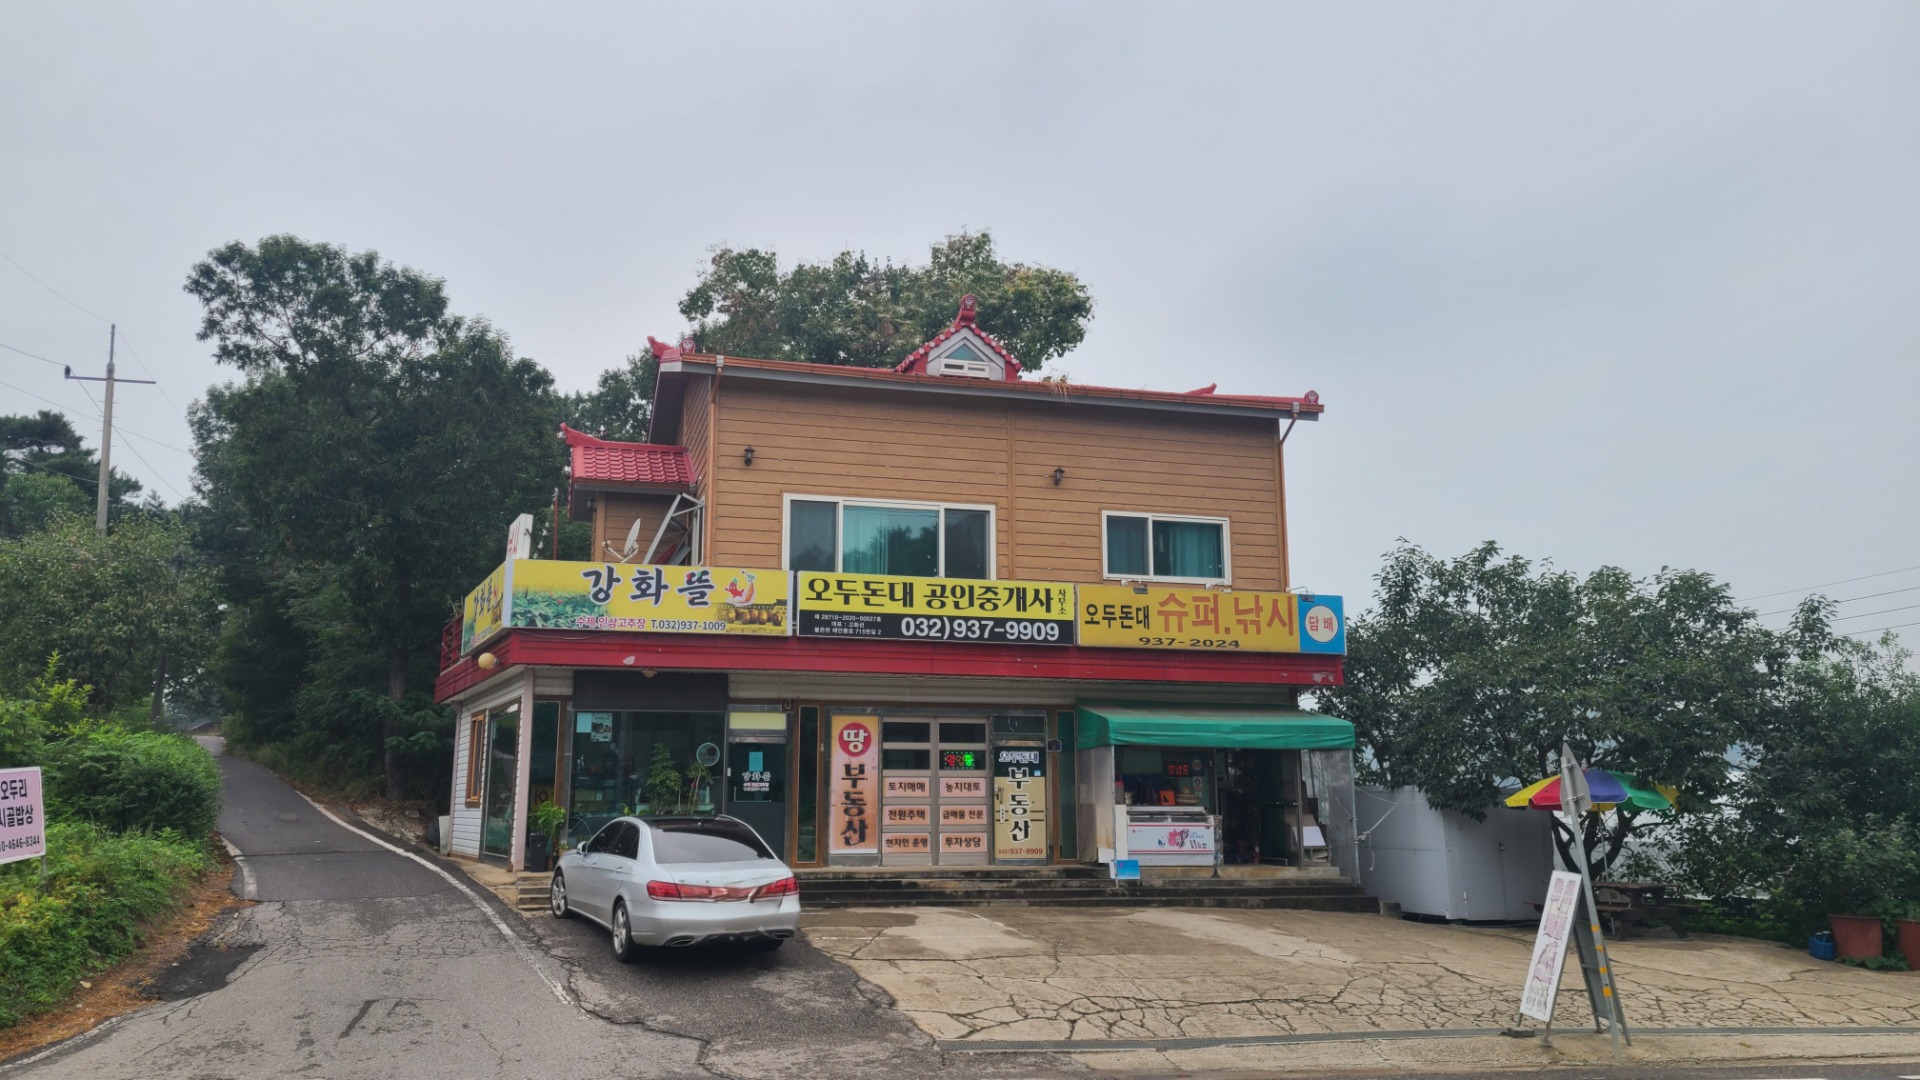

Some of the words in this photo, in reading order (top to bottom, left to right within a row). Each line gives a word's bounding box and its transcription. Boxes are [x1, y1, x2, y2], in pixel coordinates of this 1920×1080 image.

[582, 565, 715, 607] 강화뜰
[805, 578, 914, 608] 오두돈대
[923, 583, 1054, 613] 공인중개사
[1057, 588, 1067, 615] 사무소
[576, 616, 596, 628] 수제
[598, 617, 646, 629] 인삼고추장
[650, 619, 727, 632] T.032)937-1009
[1084, 603, 1150, 630] 오두돈대
[1308, 615, 1334, 633] 담배
[900, 617, 1060, 641] 032)937-9909
[1138, 637, 1240, 648] 937-2024
[842, 728, 868, 753] 땅
[0, 779, 28, 800] 오두리
[888, 782, 926, 792] 토지매매
[945, 782, 981, 792] 농지대토
[840, 763, 868, 846] 부동산
[888, 809, 926, 820] 전원주택
[942, 810, 966, 819] 급매물
[1008, 767, 1031, 844] 부동산
[945, 837, 981, 848] 투자상담
